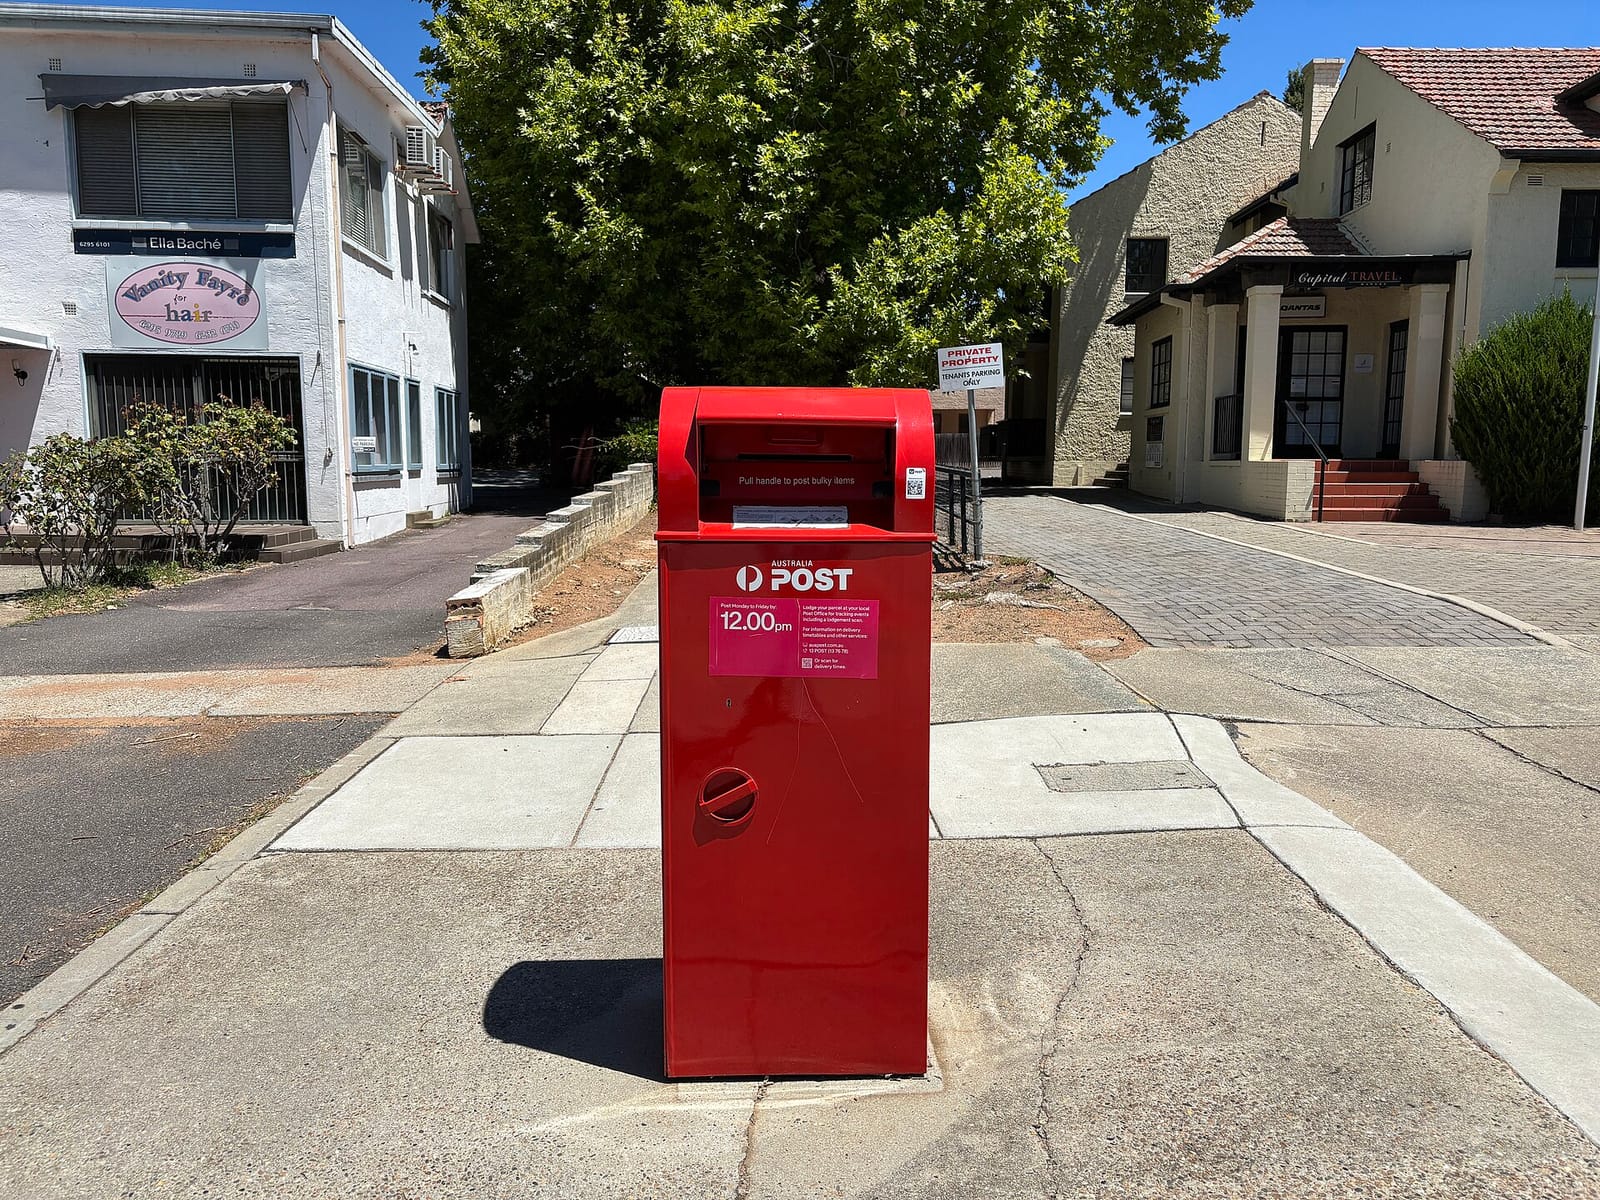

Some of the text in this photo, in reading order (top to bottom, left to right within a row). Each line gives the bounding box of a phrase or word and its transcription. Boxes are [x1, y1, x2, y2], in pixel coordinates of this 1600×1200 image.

[150, 237, 221, 250] Ella Baché
[1298, 271, 1397, 287] Capital TRAVEL
[122, 268, 250, 306] Vanity Fayre
[173, 294, 187, 304] for
[164, 303, 212, 322] hair
[947, 347, 992, 358] PRIVATE
[941, 356, 999, 368] PROPERTY
[942, 369, 1000, 380] TENANTS PARKING
[962, 378, 981, 386] ONLY
[738, 476, 754, 484] Pull
[756, 476, 781, 484] handle
[792, 478, 810, 486] post
[812, 477, 832, 486] bulky
[834, 477, 856, 485] items
[771, 568, 853, 591] POST
